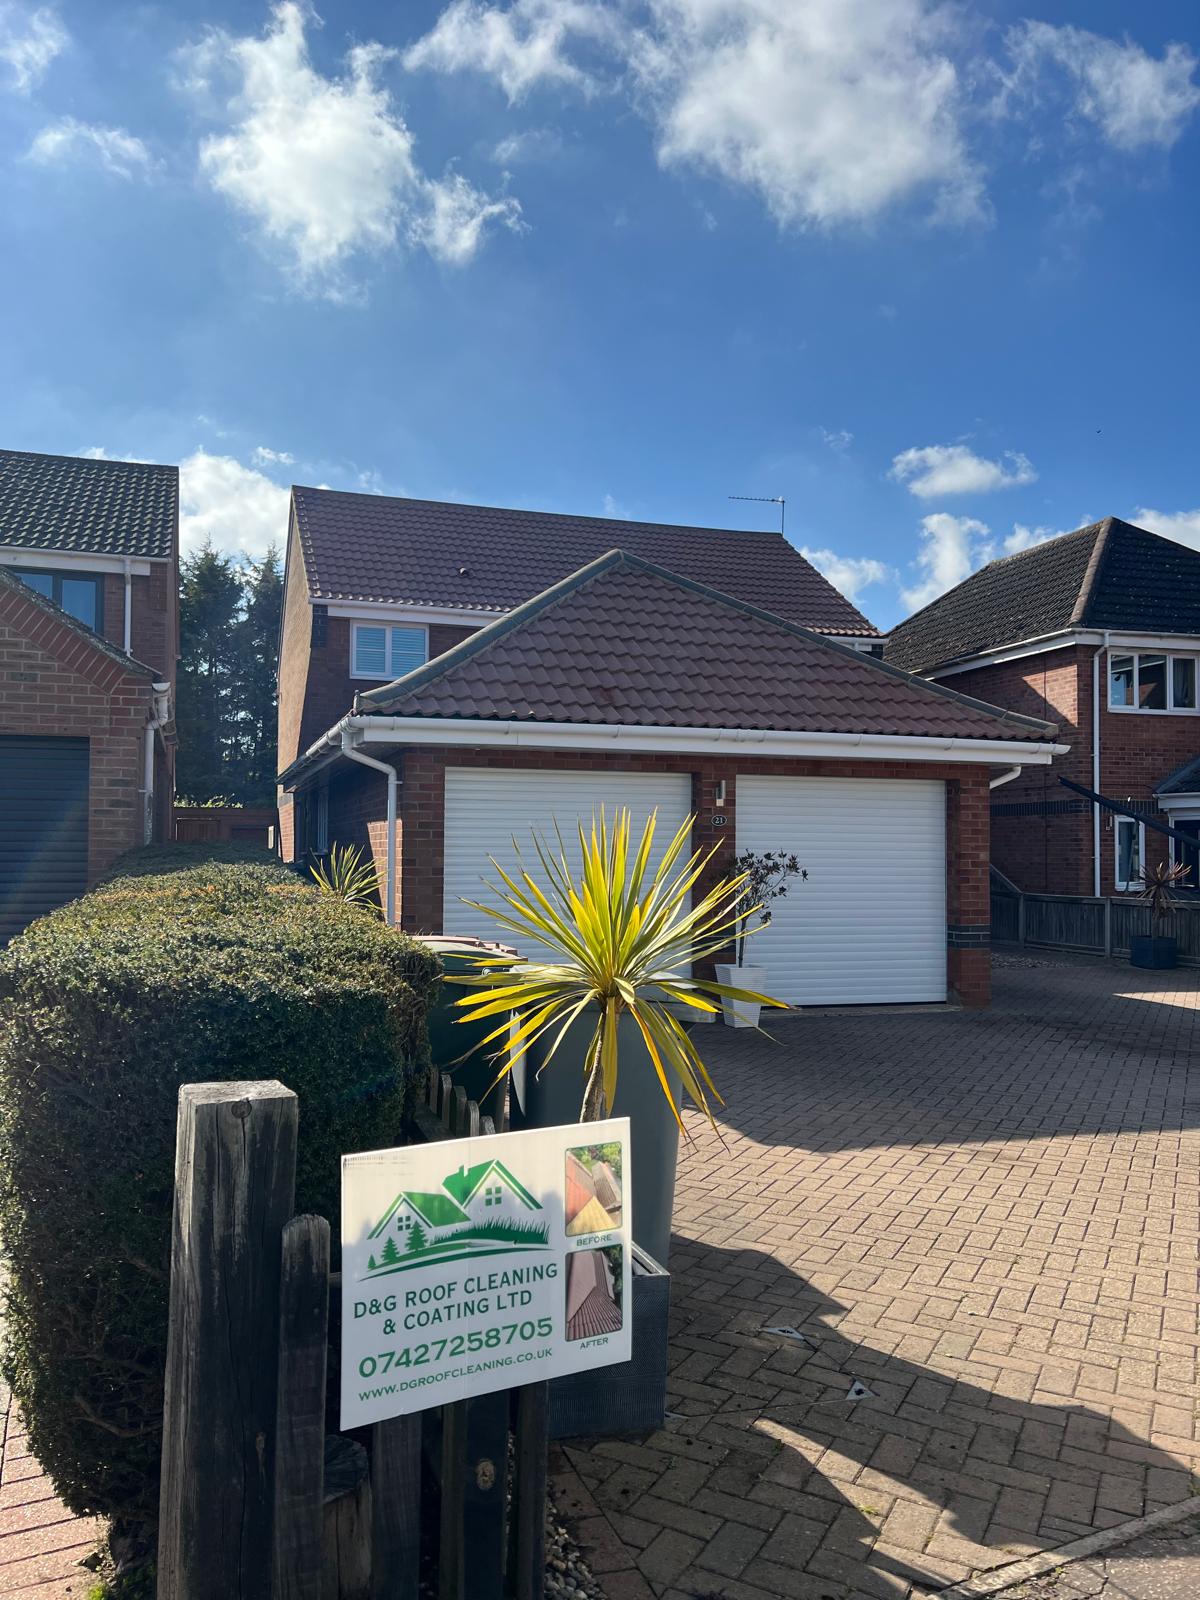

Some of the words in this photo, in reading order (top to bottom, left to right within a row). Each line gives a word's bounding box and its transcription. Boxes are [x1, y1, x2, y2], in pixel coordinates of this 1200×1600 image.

[576, 1234, 612, 1247] BEFORE
[354, 1295, 397, 1319] D&G
[405, 1281, 457, 1308] ROOF
[464, 1263, 558, 1295] CLEANING
[382, 1319, 396, 1335] &
[404, 1299, 489, 1331] COATING
[497, 1290, 532, 1310] LTD
[358, 1317, 553, 1378] 07427258705
[579, 1337, 609, 1349] AFTER
[358, 1348, 553, 1401] WWW.DGROOFCLEANING.CO.UK
